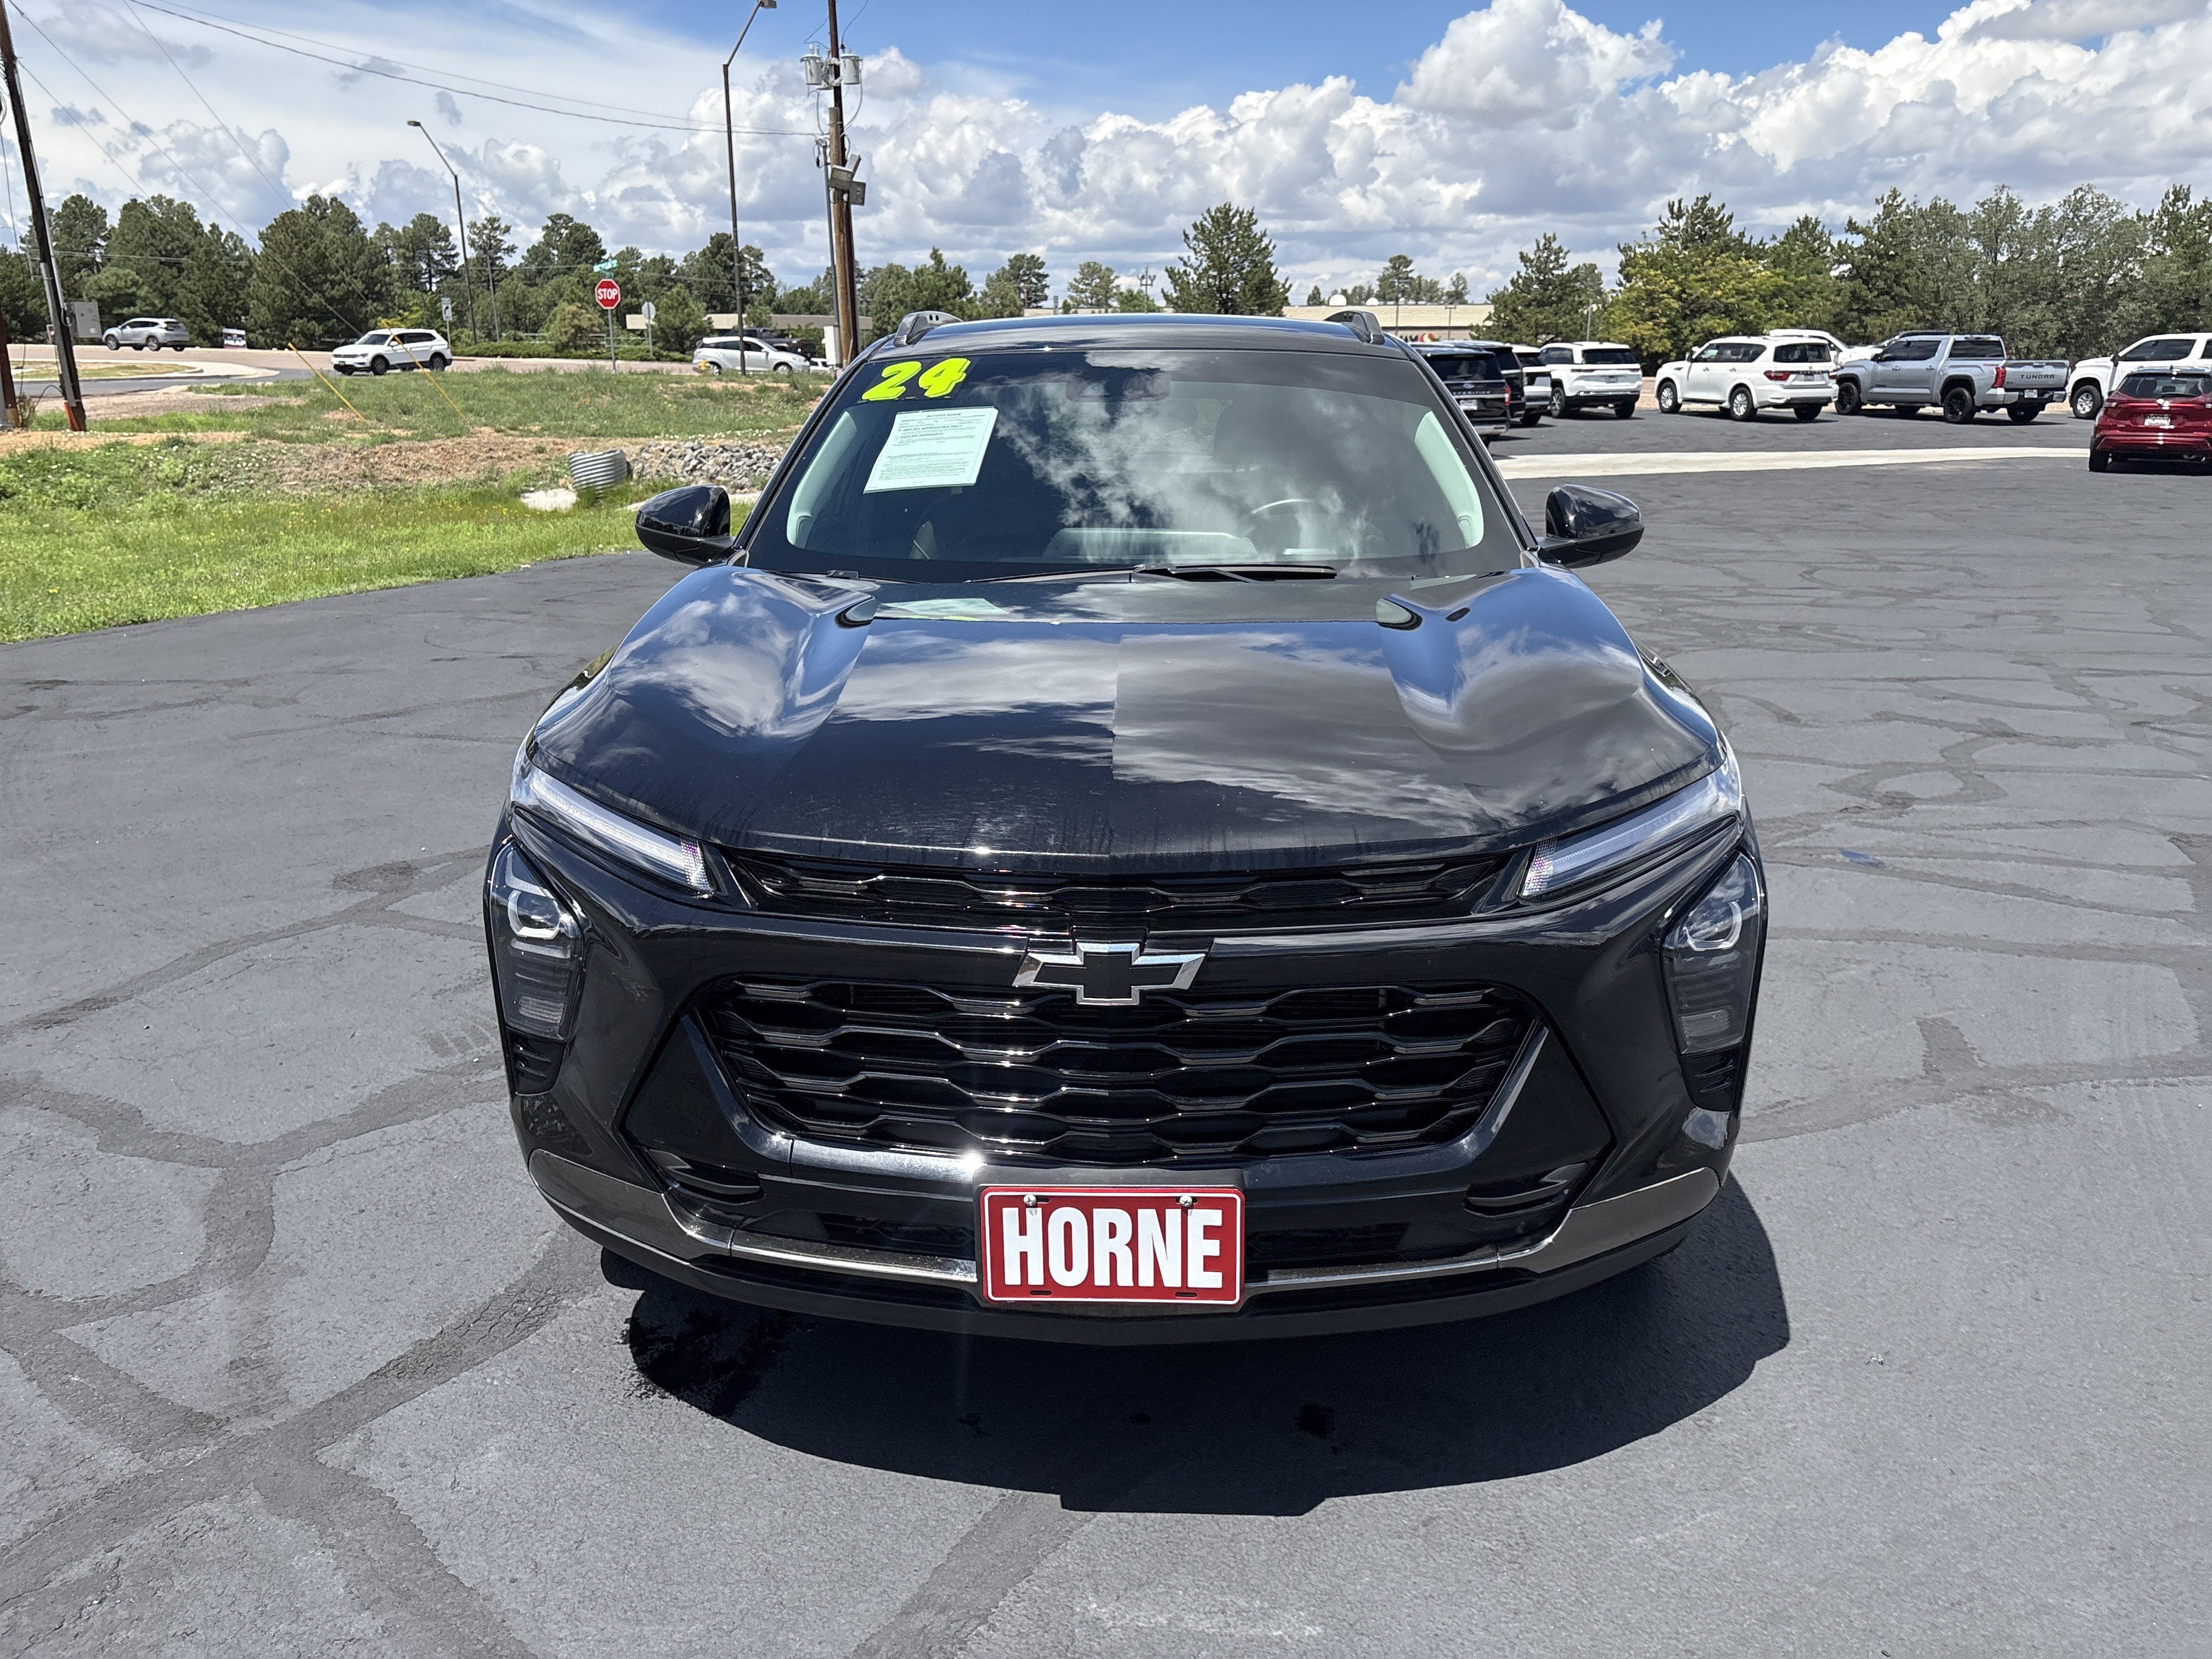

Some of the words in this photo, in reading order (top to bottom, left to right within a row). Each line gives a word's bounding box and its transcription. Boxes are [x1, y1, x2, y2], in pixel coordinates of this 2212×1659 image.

[597, 288, 618, 300] STOP
[861, 358, 971, 401] 24
[1001, 1206, 1223, 1288] HORNE
